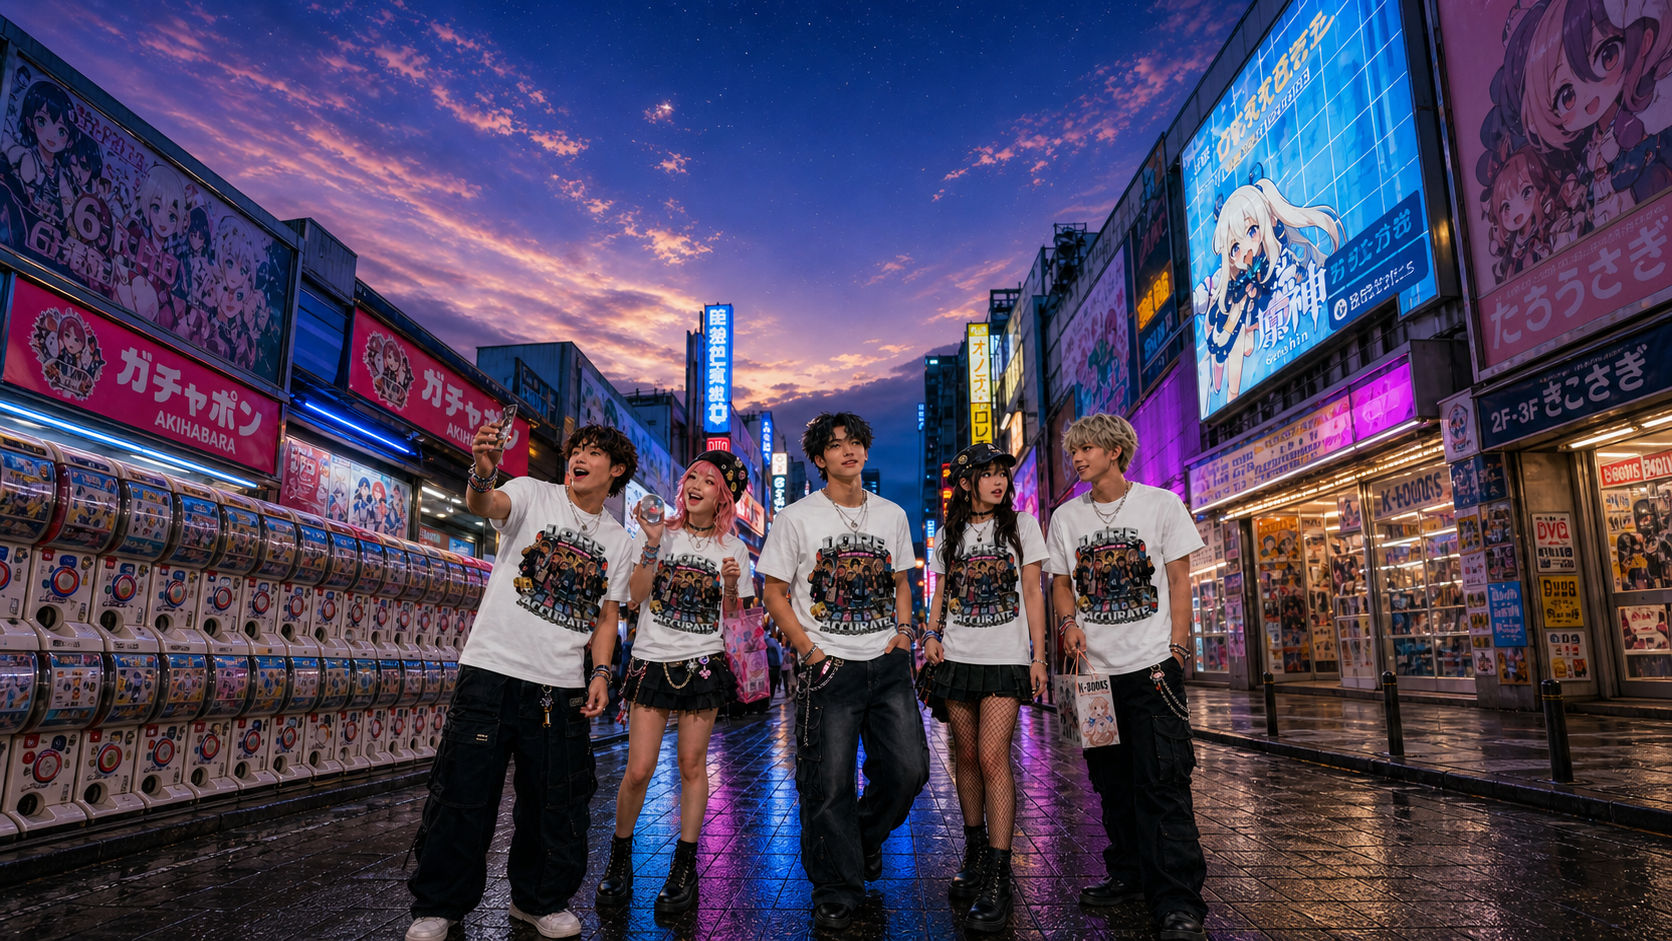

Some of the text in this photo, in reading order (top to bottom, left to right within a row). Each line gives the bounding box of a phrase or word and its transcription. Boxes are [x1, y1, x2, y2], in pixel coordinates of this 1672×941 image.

[1490, 215, 1669, 350] たろうさぎ
[116, 346, 262, 437] ガチャポン
[154, 410, 236, 455] AKIHABARA
